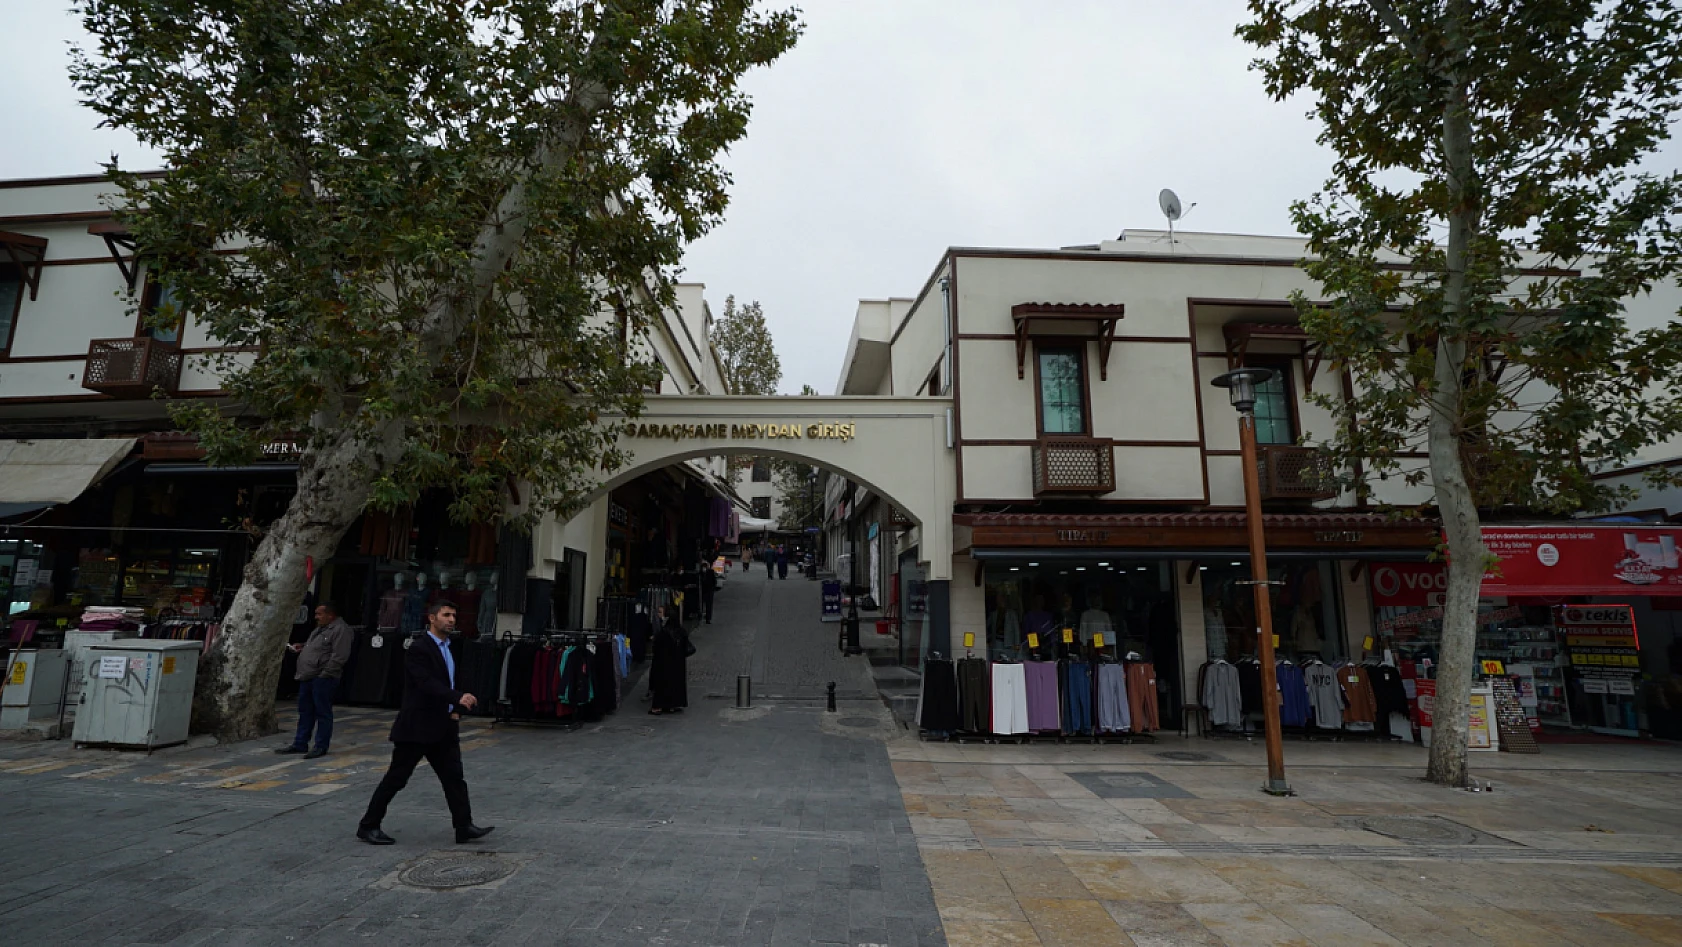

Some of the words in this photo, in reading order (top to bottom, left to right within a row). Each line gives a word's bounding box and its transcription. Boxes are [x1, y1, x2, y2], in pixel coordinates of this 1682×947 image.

[731, 423, 801, 440] MEYDAN
[807, 420, 855, 443] GİRİŞİ
[1586, 609, 1628, 624] tekiş
[1312, 674, 1331, 686] NYC
